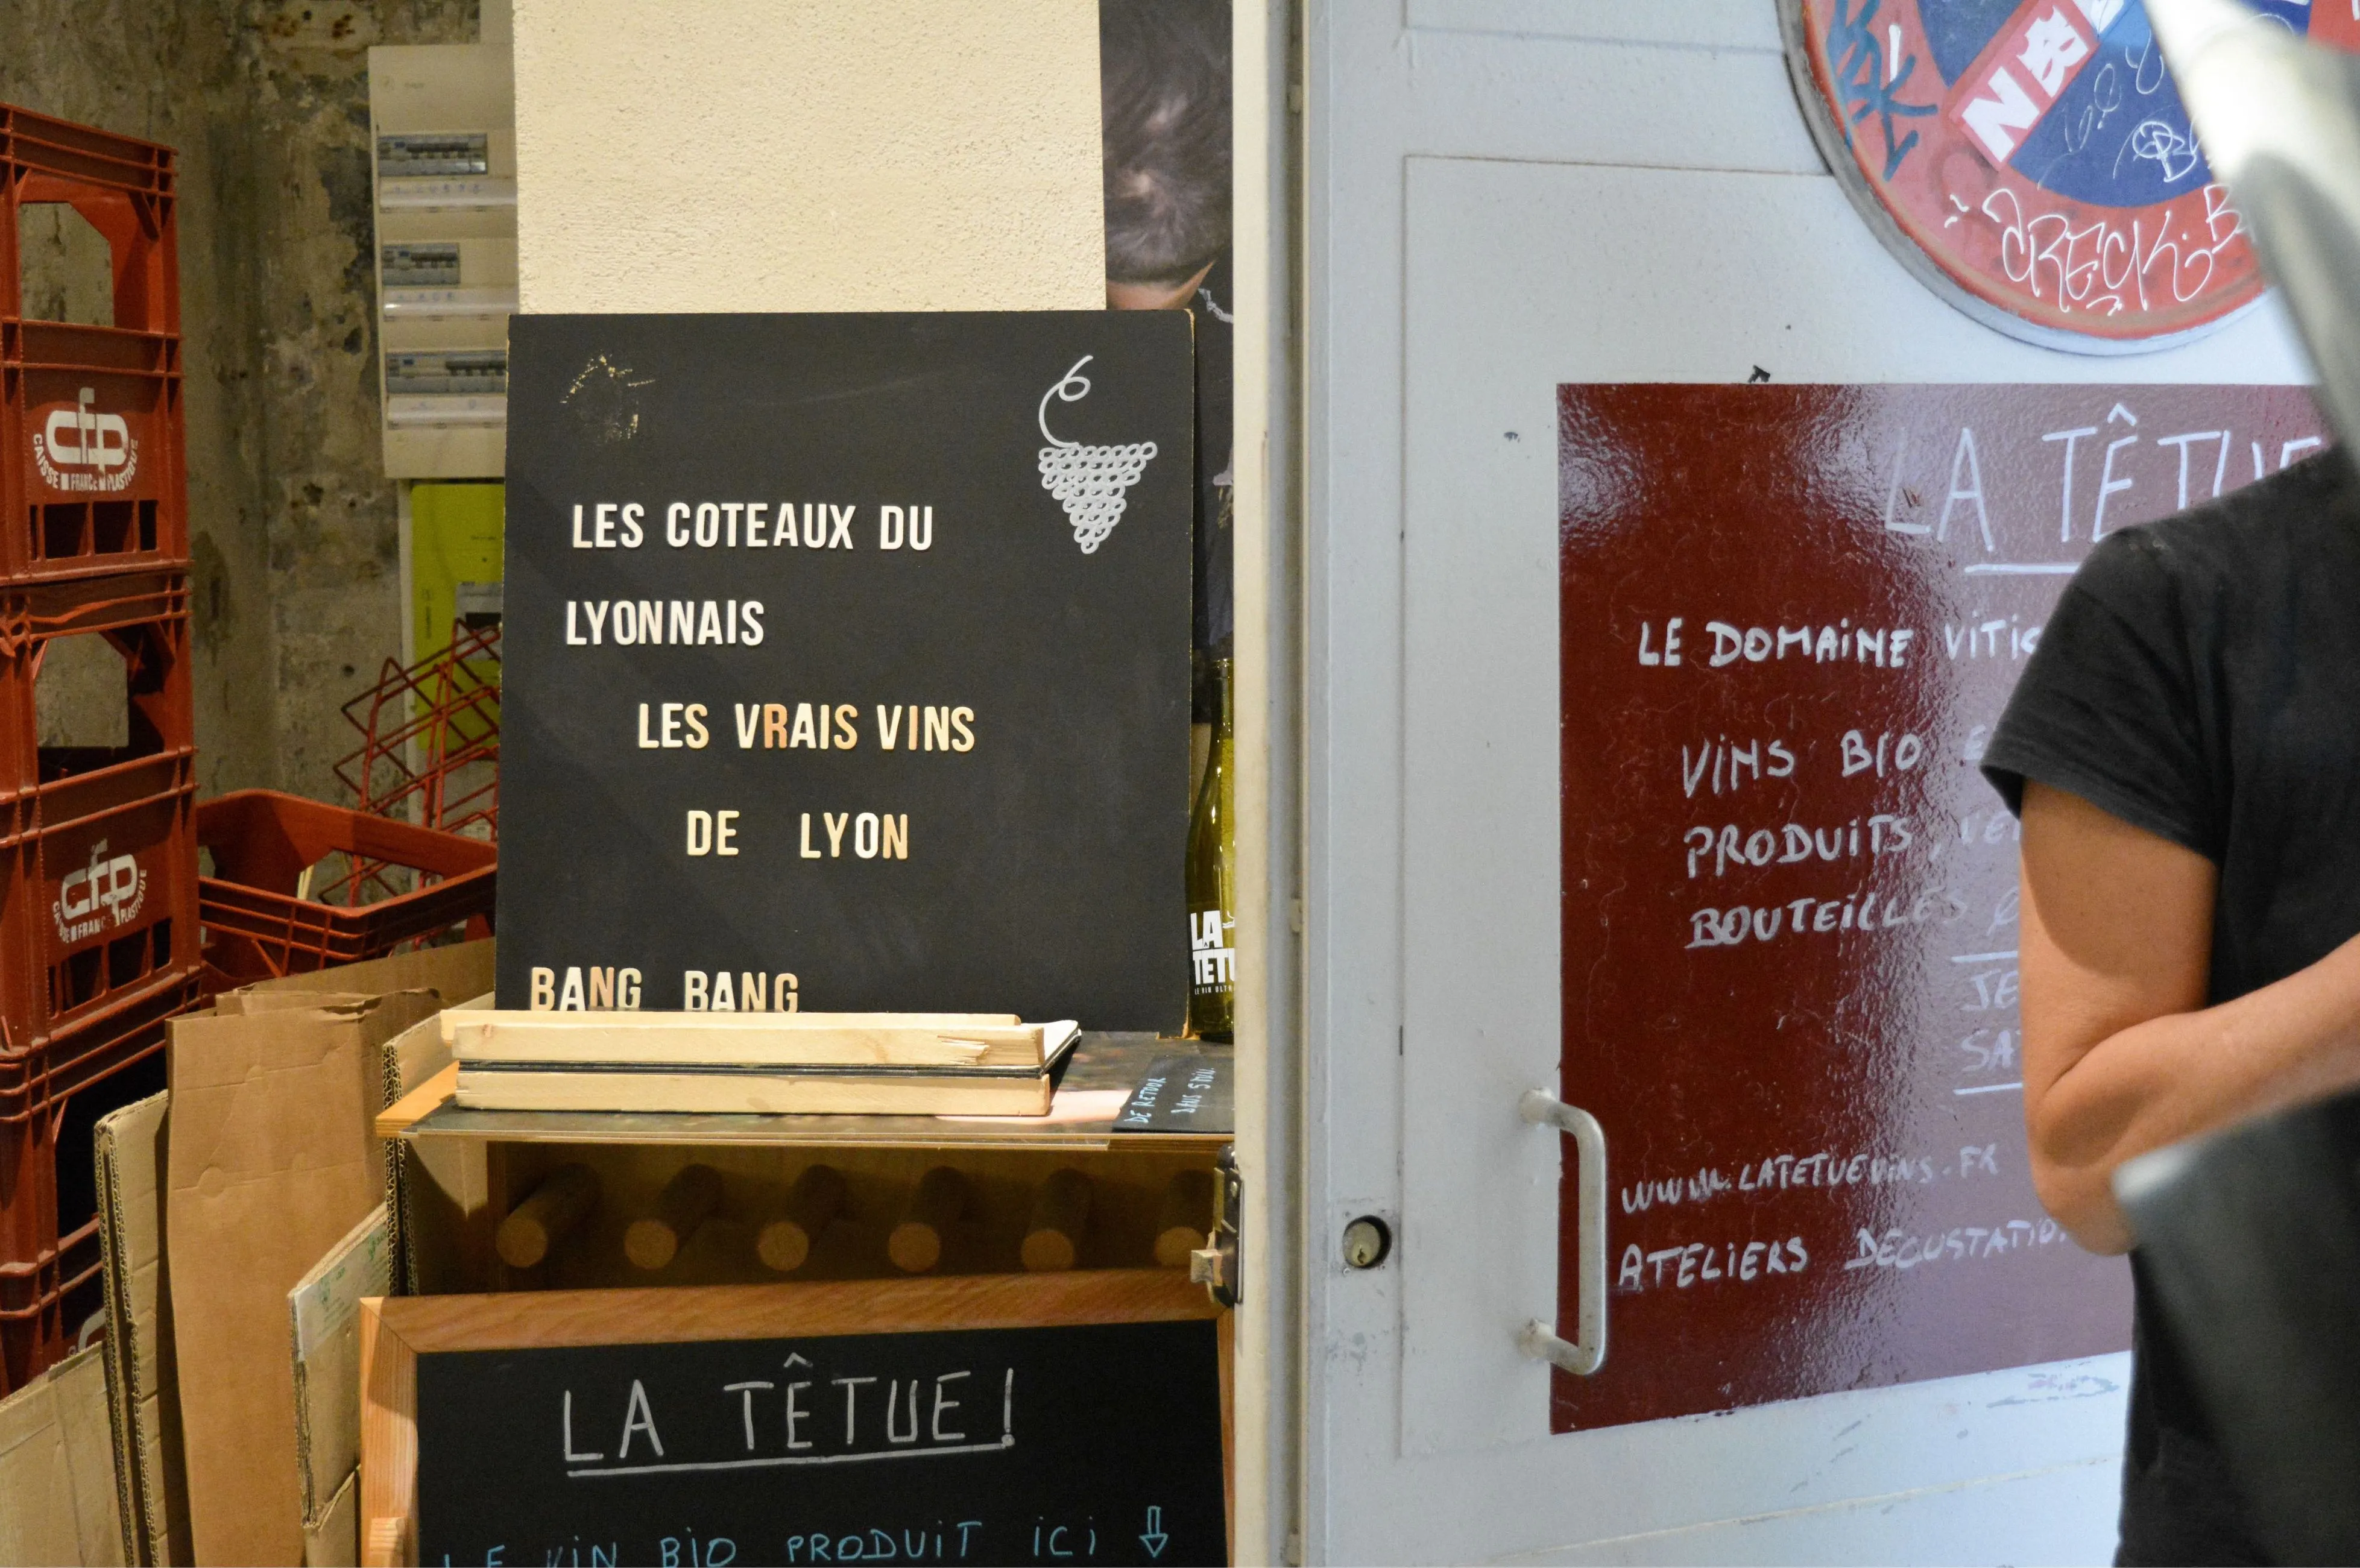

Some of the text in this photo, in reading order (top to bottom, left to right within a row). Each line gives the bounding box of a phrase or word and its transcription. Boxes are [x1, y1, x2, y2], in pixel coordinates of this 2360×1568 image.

[1884, 427, 1995, 552] LA
[573, 502, 933, 550] LES COTEAUX DU
[566, 600, 765, 646] LYONNAIS
[1638, 617, 1682, 666] LE
[638, 703, 975, 752] LES VRAIS VINS
[687, 810, 908, 859] DE LYON
[1190, 910, 1223, 950] LA
[530, 966, 799, 1014] BANG BANG
[1124, 1077, 1167, 1123] DE RETOUR
[1844, 1218, 2067, 1270] DEGUSTATIO
[563, 1379, 663, 1461] LA
